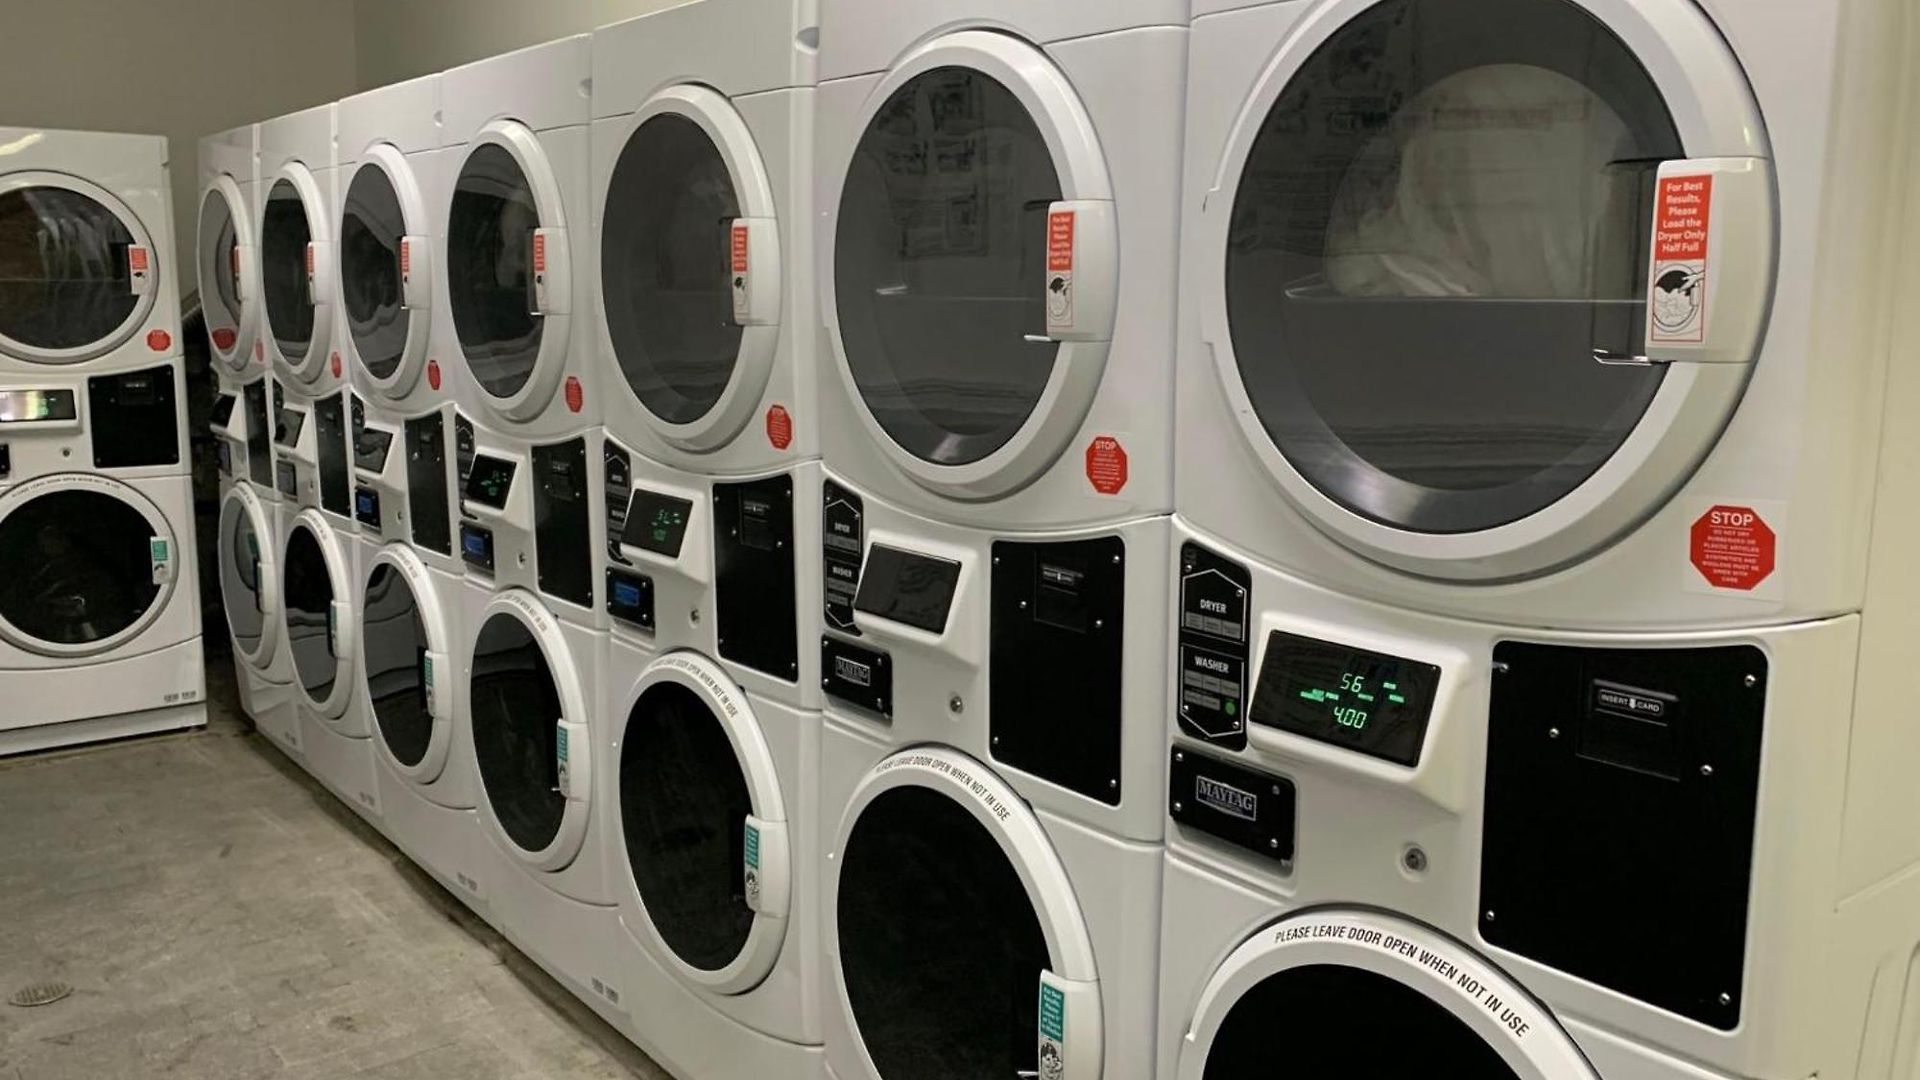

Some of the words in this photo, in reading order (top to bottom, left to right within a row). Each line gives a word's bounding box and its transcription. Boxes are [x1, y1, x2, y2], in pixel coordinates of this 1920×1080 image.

[1667, 182, 1682, 191] For
[1683, 181, 1703, 191] Best
[1668, 206, 1698, 216] Please
[1663, 219, 1685, 229] Load
[1686, 218, 1702, 228] the
[1658, 231, 1683, 242] Dryer
[1684, 230, 1706, 241] Only
[1662, 242, 1681, 252] Half
[1682, 241, 1699, 251] Full
[1095, 440, 1116, 450] STOP
[1711, 511, 1754, 526] STOP
[1200, 598, 1227, 614] DRYER
[1194, 655, 1230, 674] WASHER
[1340, 672, 1364, 693] 56
[1637, 701, 1660, 712] CARD
[931, 759, 952, 773] OPEN
[950, 766, 973, 785] WHEN
[969, 781, 989, 797] NOT
[984, 792, 997, 806] IN
[993, 803, 1011, 822] USE
[1199, 780, 1253, 810] MAYTAG
[1275, 925, 1311, 943] PLEASE
[1312, 925, 1347, 939] LEAVE
[1347, 927, 1382, 945] DOOR
[1383, 936, 1418, 958] OPEN
[1418, 949, 1458, 980] WHEN
[1457, 973, 1488, 998] NOT
[1484, 994, 1503, 1012] IN
[1500, 1008, 1530, 1037] USE
